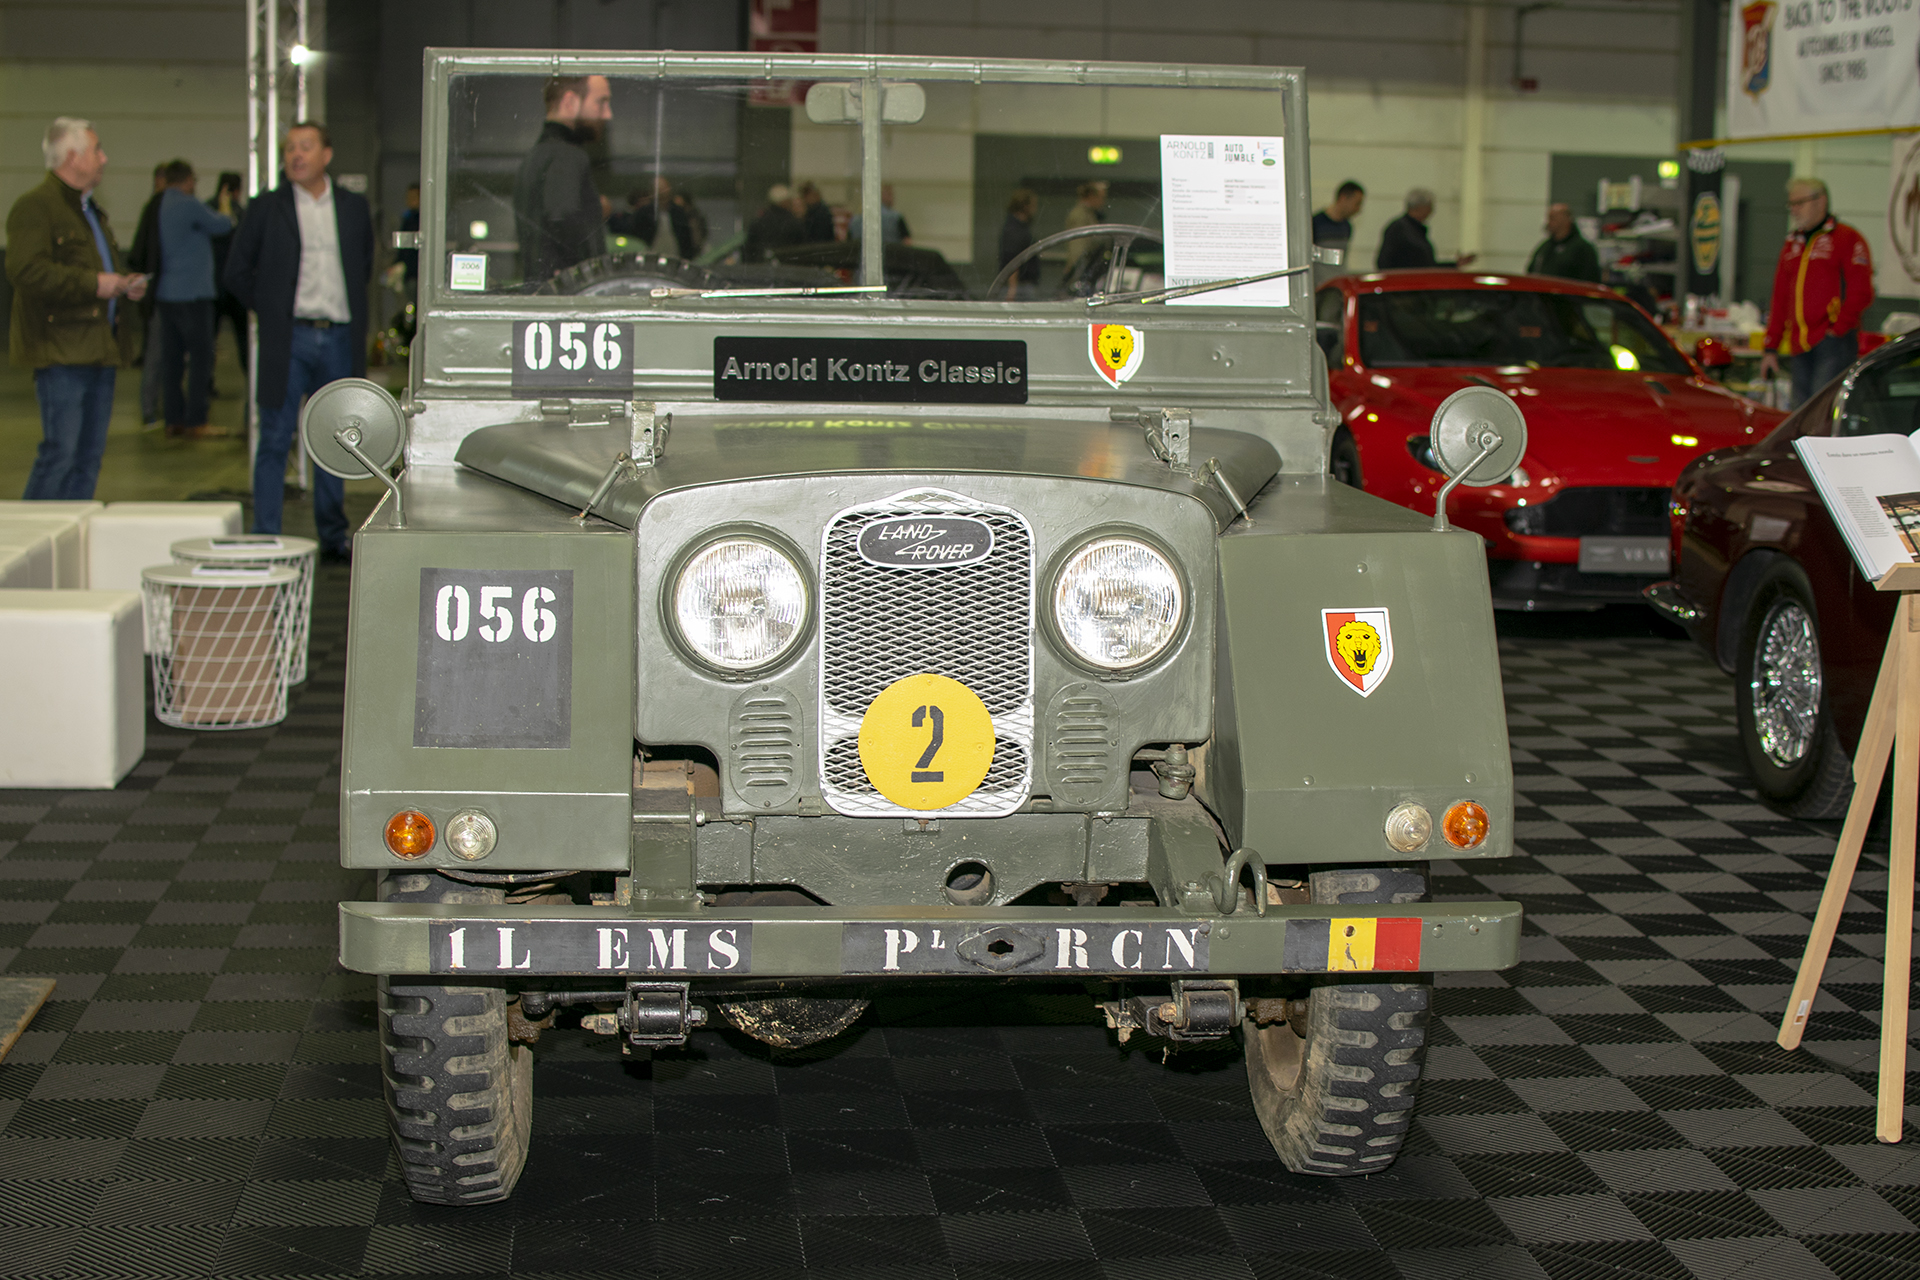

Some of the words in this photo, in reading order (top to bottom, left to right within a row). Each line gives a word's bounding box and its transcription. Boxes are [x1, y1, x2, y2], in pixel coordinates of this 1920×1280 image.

[1166, 141, 1207, 150] ARNOLD
[1224, 143, 1244, 153] AUTO
[1173, 150, 1206, 159] KONTZ
[1224, 153, 1256, 163] JUMBLE
[461, 262, 480, 270] 2006
[1171, 278, 1191, 287] NOT
[523, 321, 624, 372] 056
[721, 356, 818, 382] Arnold
[828, 358, 911, 383] Kontz
[918, 358, 1022, 386] Classic
[878, 523, 935, 541] LAND
[911, 543, 974, 560] ROVER
[434, 583, 558, 643] 056
[909, 705, 945, 784] 2
[596, 927, 742, 970] EMS
[1054, 928, 1202, 970] RCN
